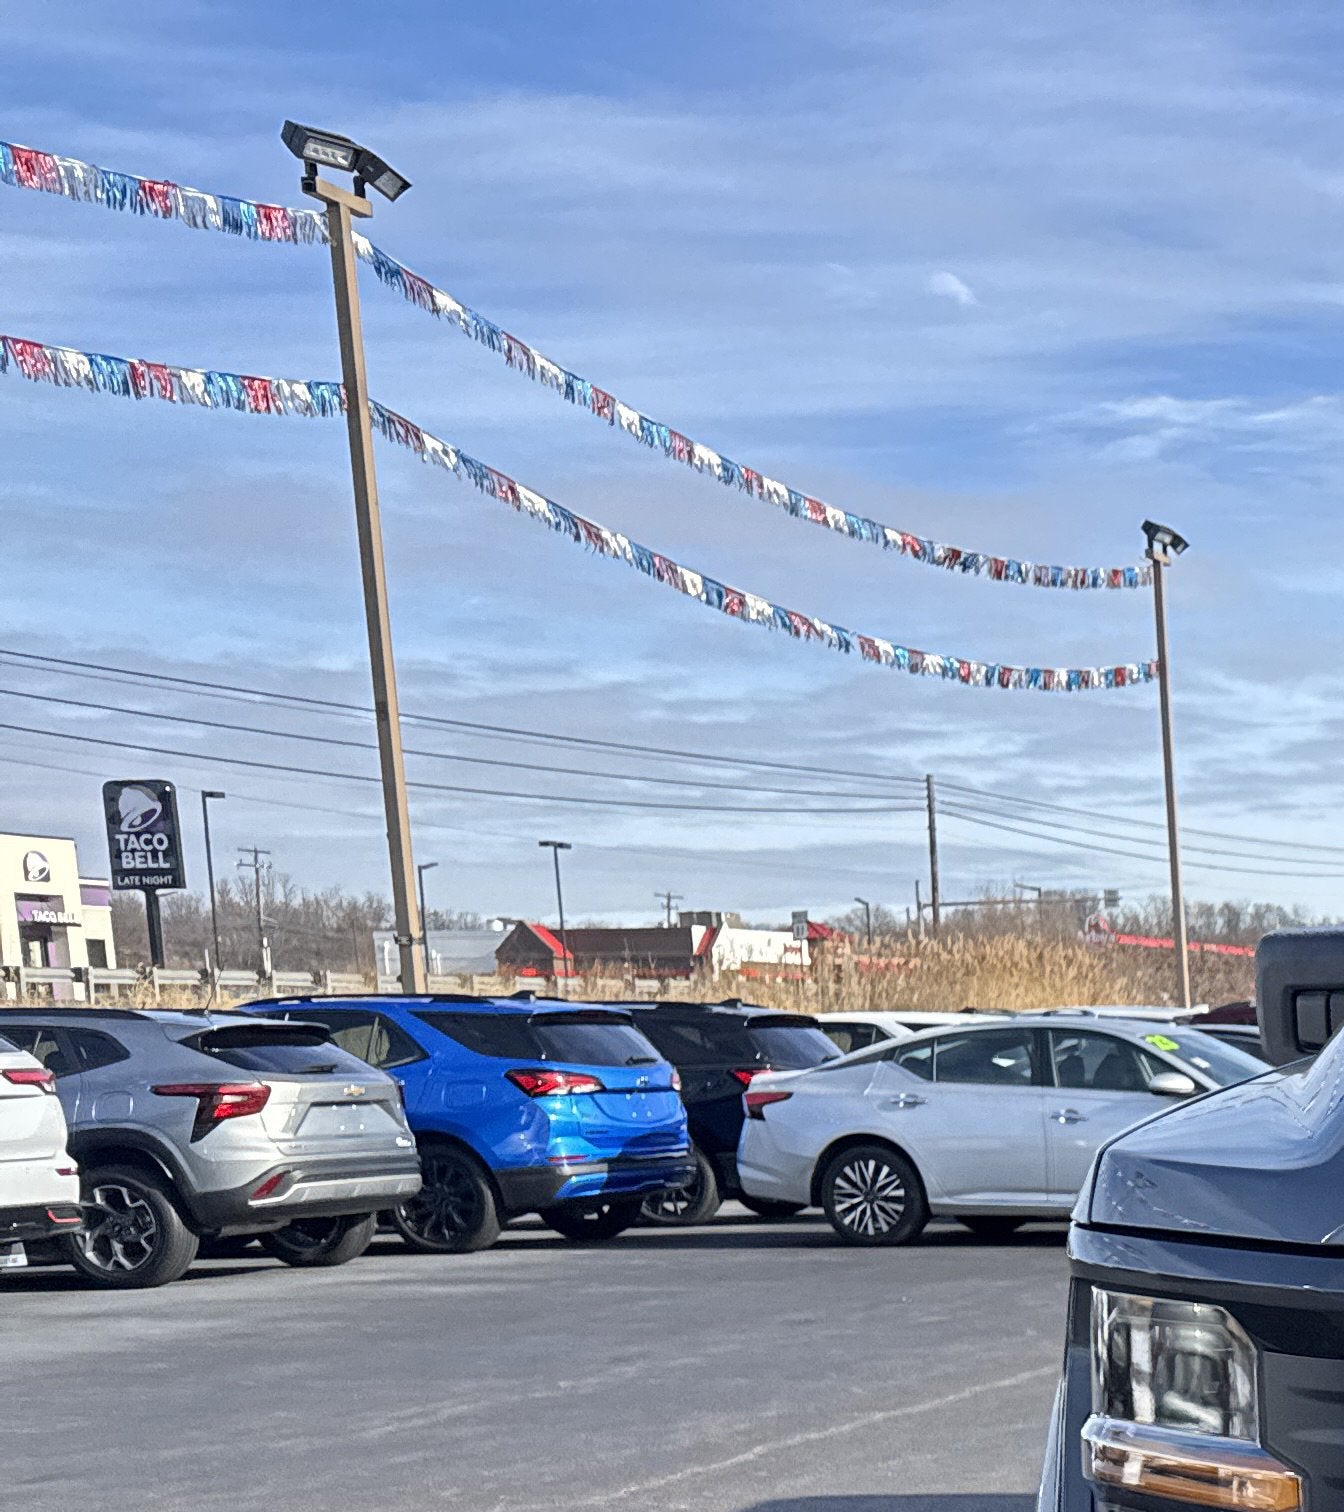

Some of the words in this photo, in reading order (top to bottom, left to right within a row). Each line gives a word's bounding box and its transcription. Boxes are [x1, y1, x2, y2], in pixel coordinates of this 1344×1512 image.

[114, 833, 169, 851] TACO
[121, 852, 171, 869] BELL
[117, 876, 140, 886] LATE
[141, 875, 173, 885] NIGHT
[32, 910, 57, 923] TACO
